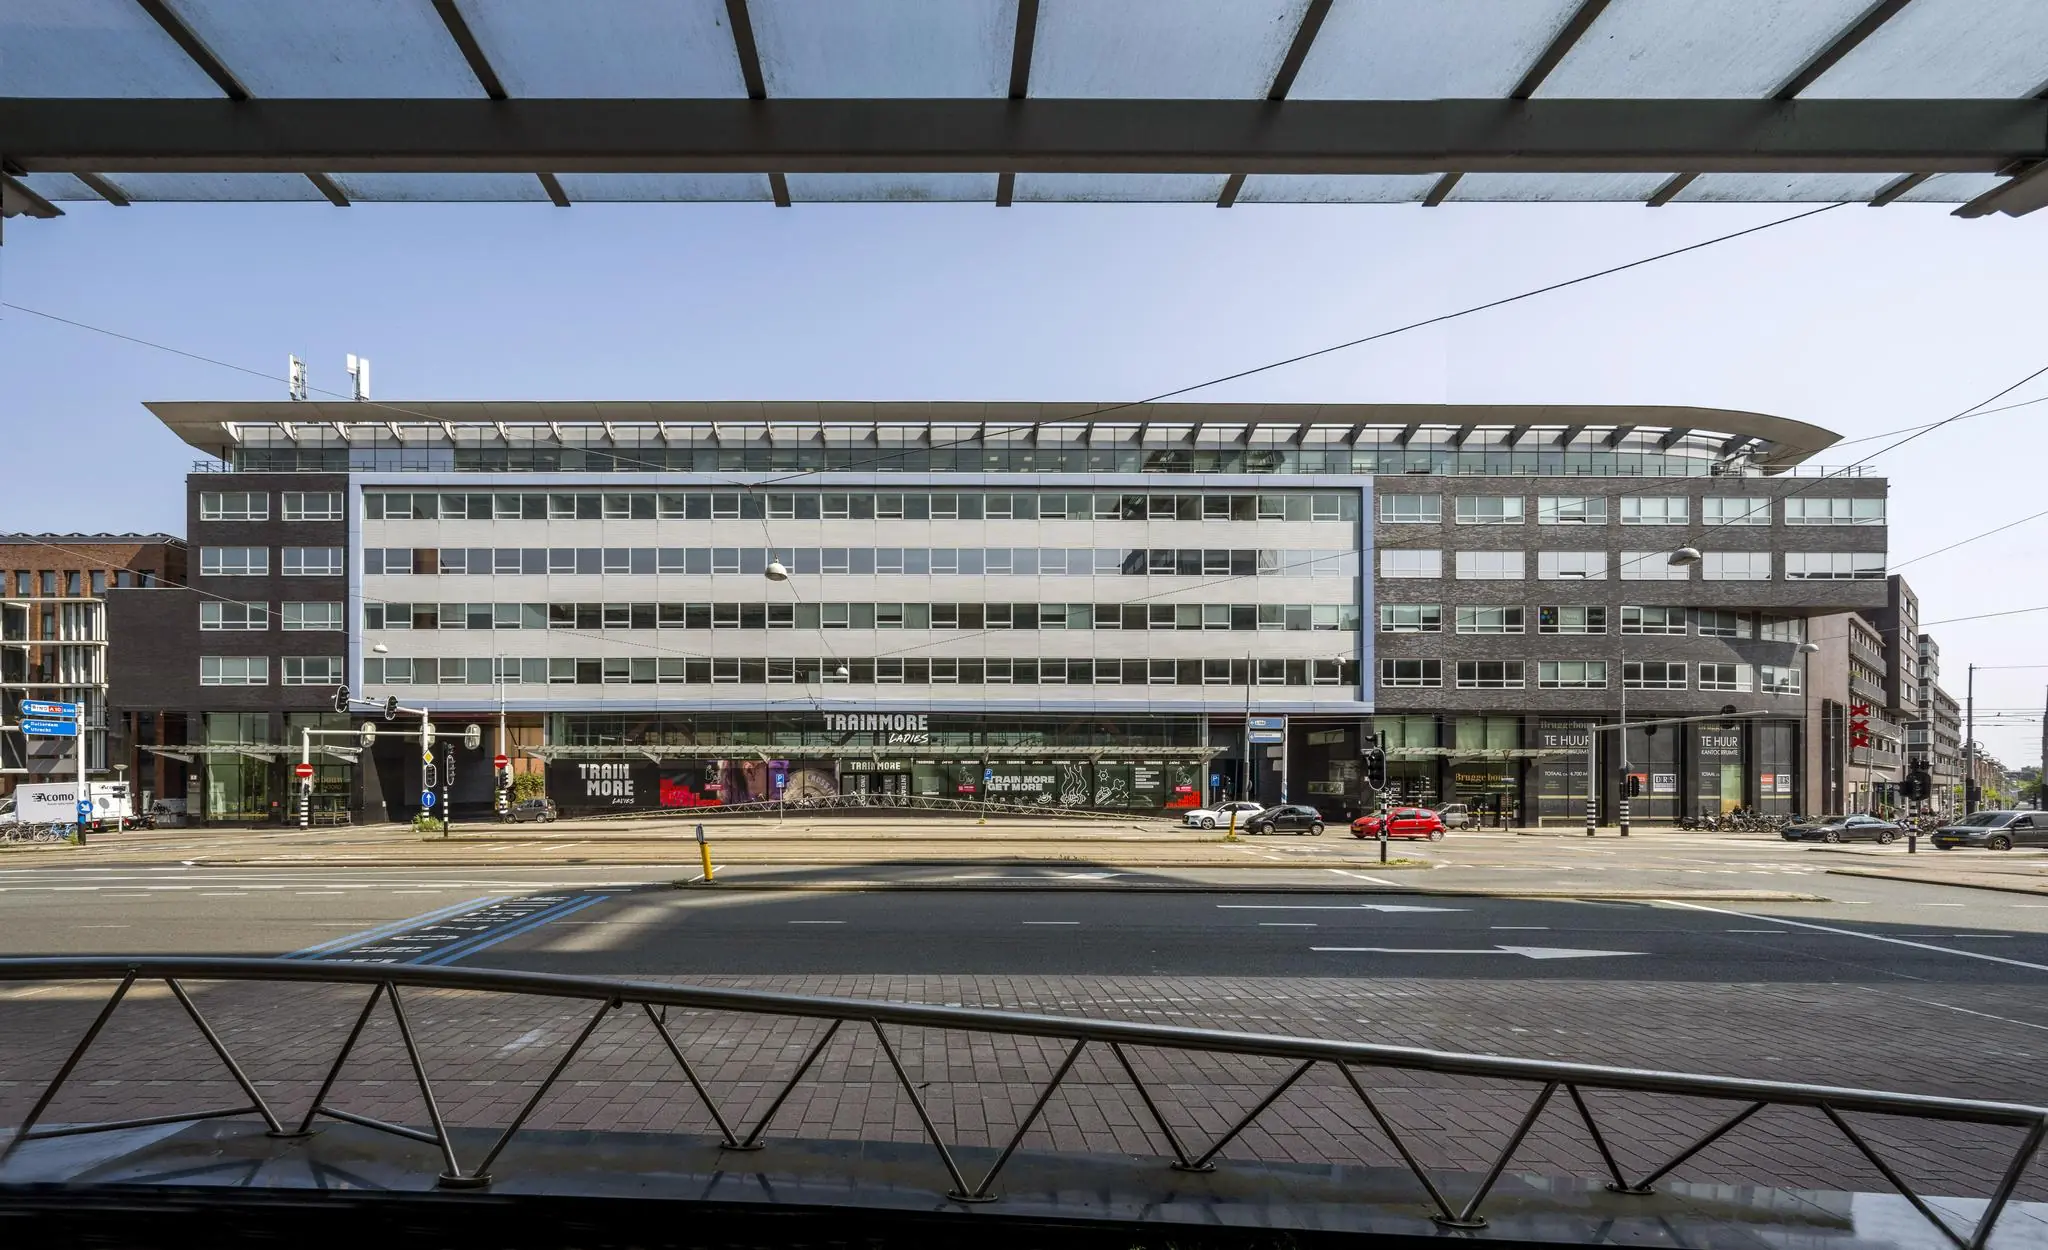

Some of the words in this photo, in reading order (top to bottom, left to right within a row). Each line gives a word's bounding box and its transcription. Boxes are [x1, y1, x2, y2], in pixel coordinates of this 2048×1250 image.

[824, 714, 928, 731] TRAINMORE
[888, 733, 929, 743] LADIES
[1544, 735, 1557, 746] TE
[1701, 736, 1711, 746] TE
[1714, 736, 1738, 746] HUUR
[579, 763, 630, 779] TRAIN
[1023, 775, 1055, 783] MORE
[587, 780, 634, 796] MORE
[987, 783, 1010, 791] GET
[1011, 783, 1043, 791] MORE
[39, 793, 74, 802] Acomo
